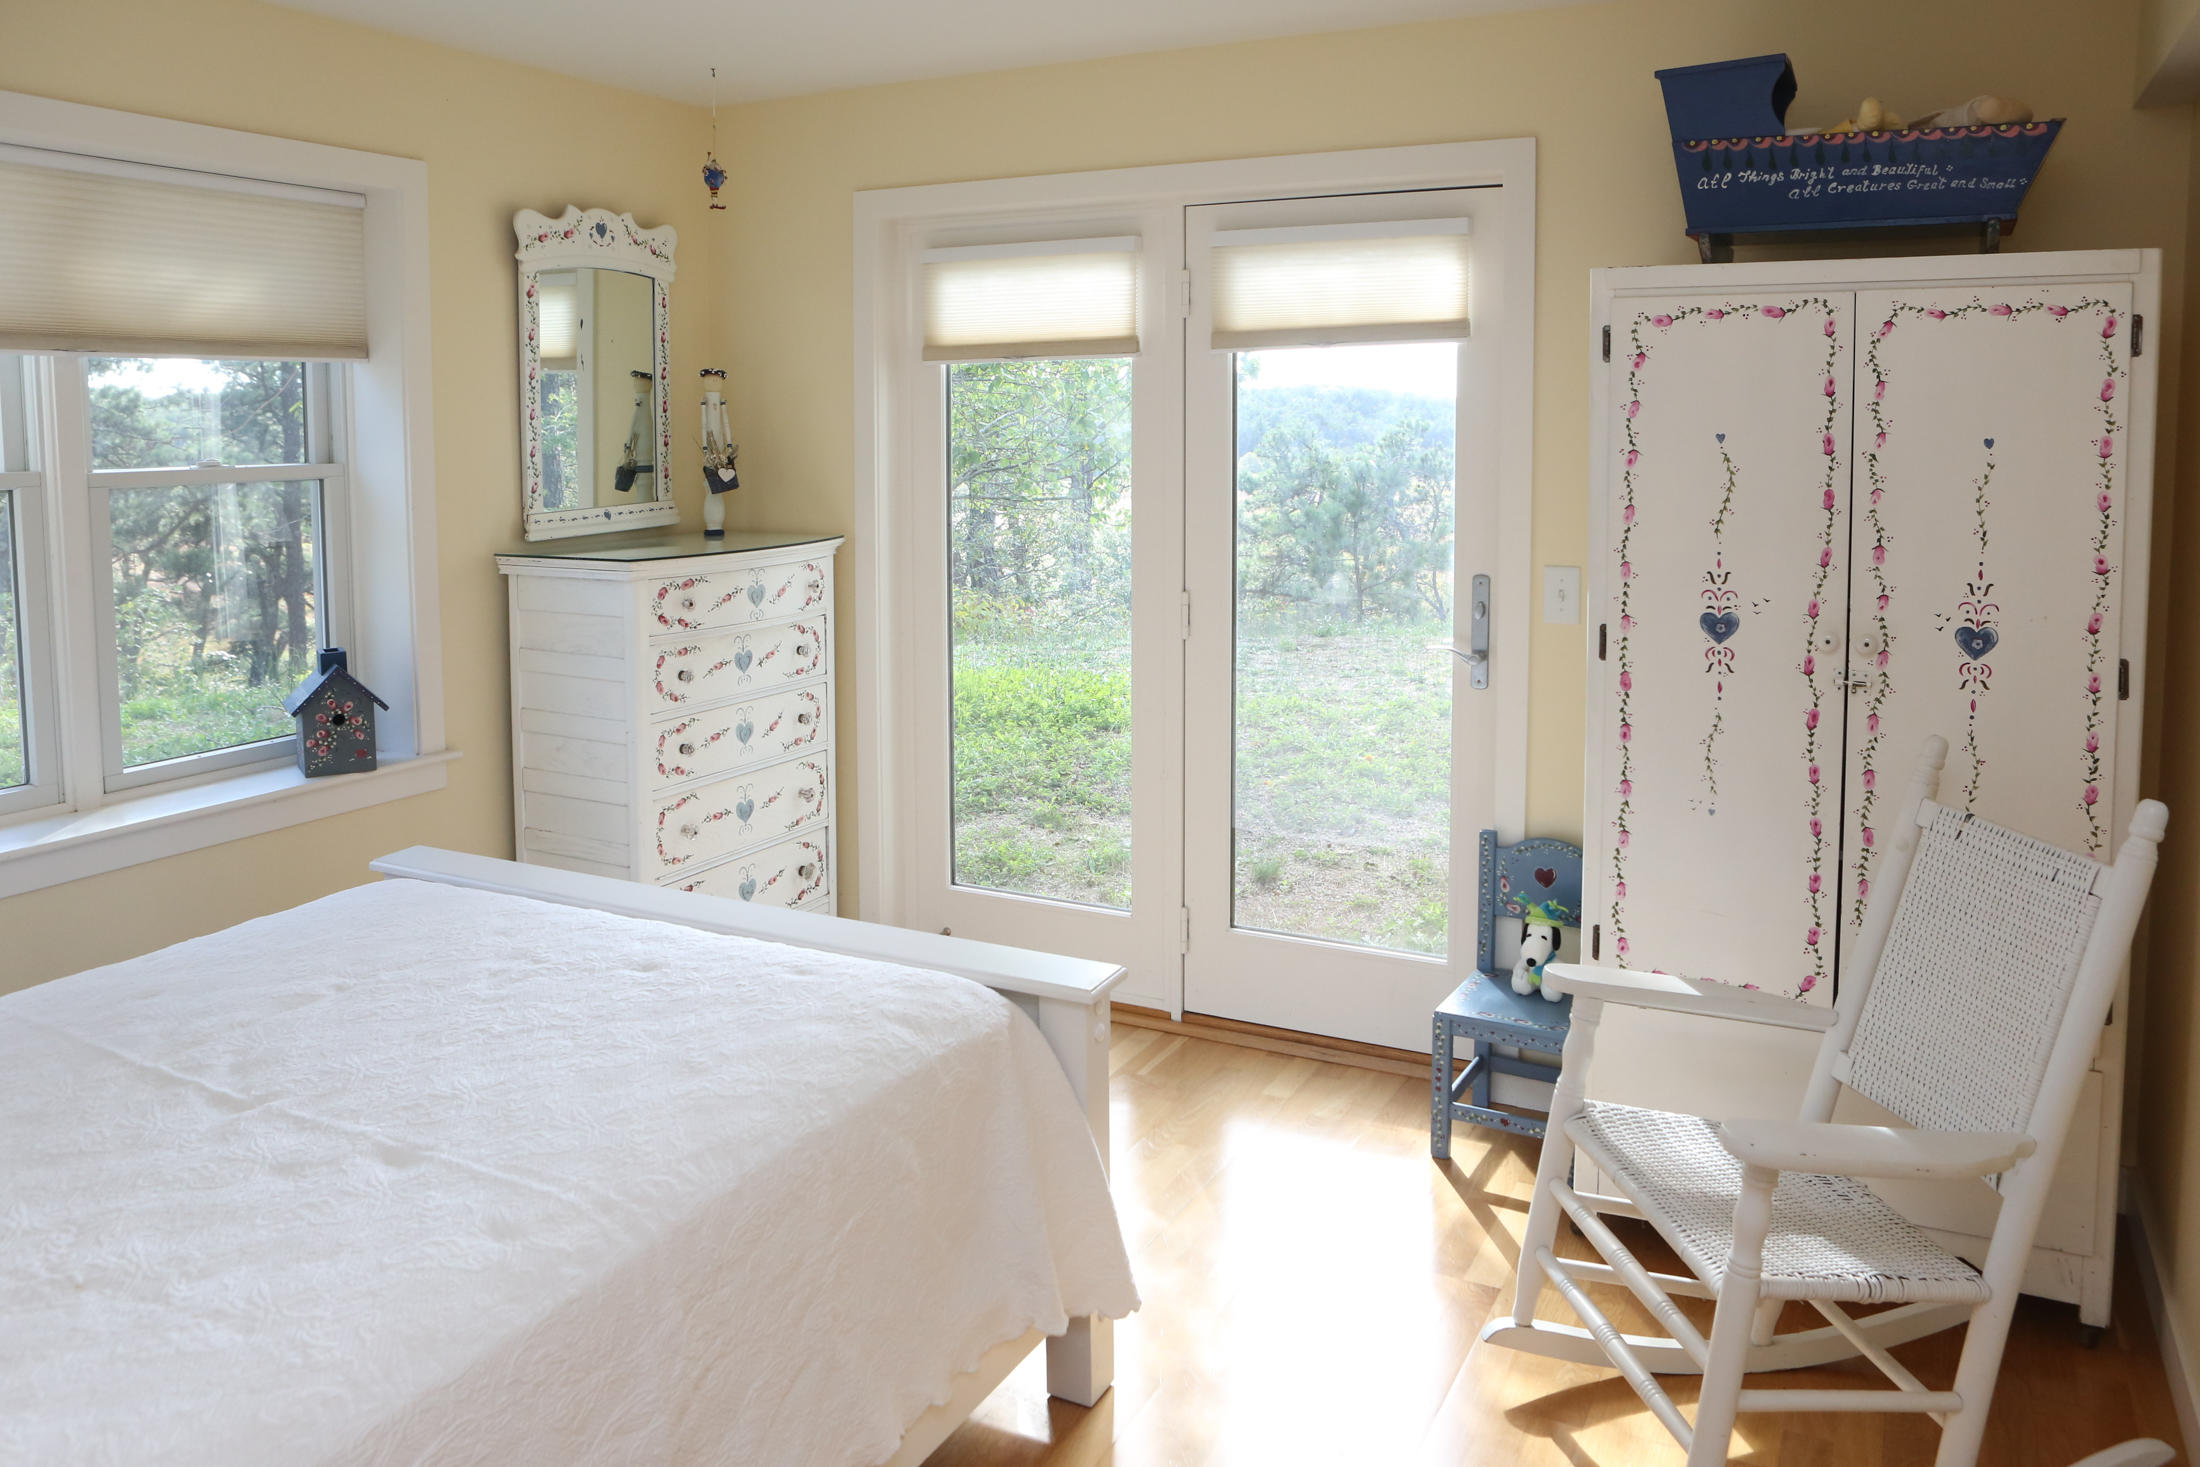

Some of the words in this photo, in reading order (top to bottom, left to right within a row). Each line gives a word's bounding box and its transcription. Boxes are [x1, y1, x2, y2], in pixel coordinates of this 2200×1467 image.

[1738, 170, 1785, 186] Things
[1790, 167, 1835, 184] Bright
[1841, 165, 1868, 177] and
[1871, 163, 1939, 178] Beautiful
[1827, 180, 1902, 194] Creatures
[1906, 176, 1948, 190] Great
[1950, 177, 1976, 189] and
[1979, 177, 2017, 190] Small
